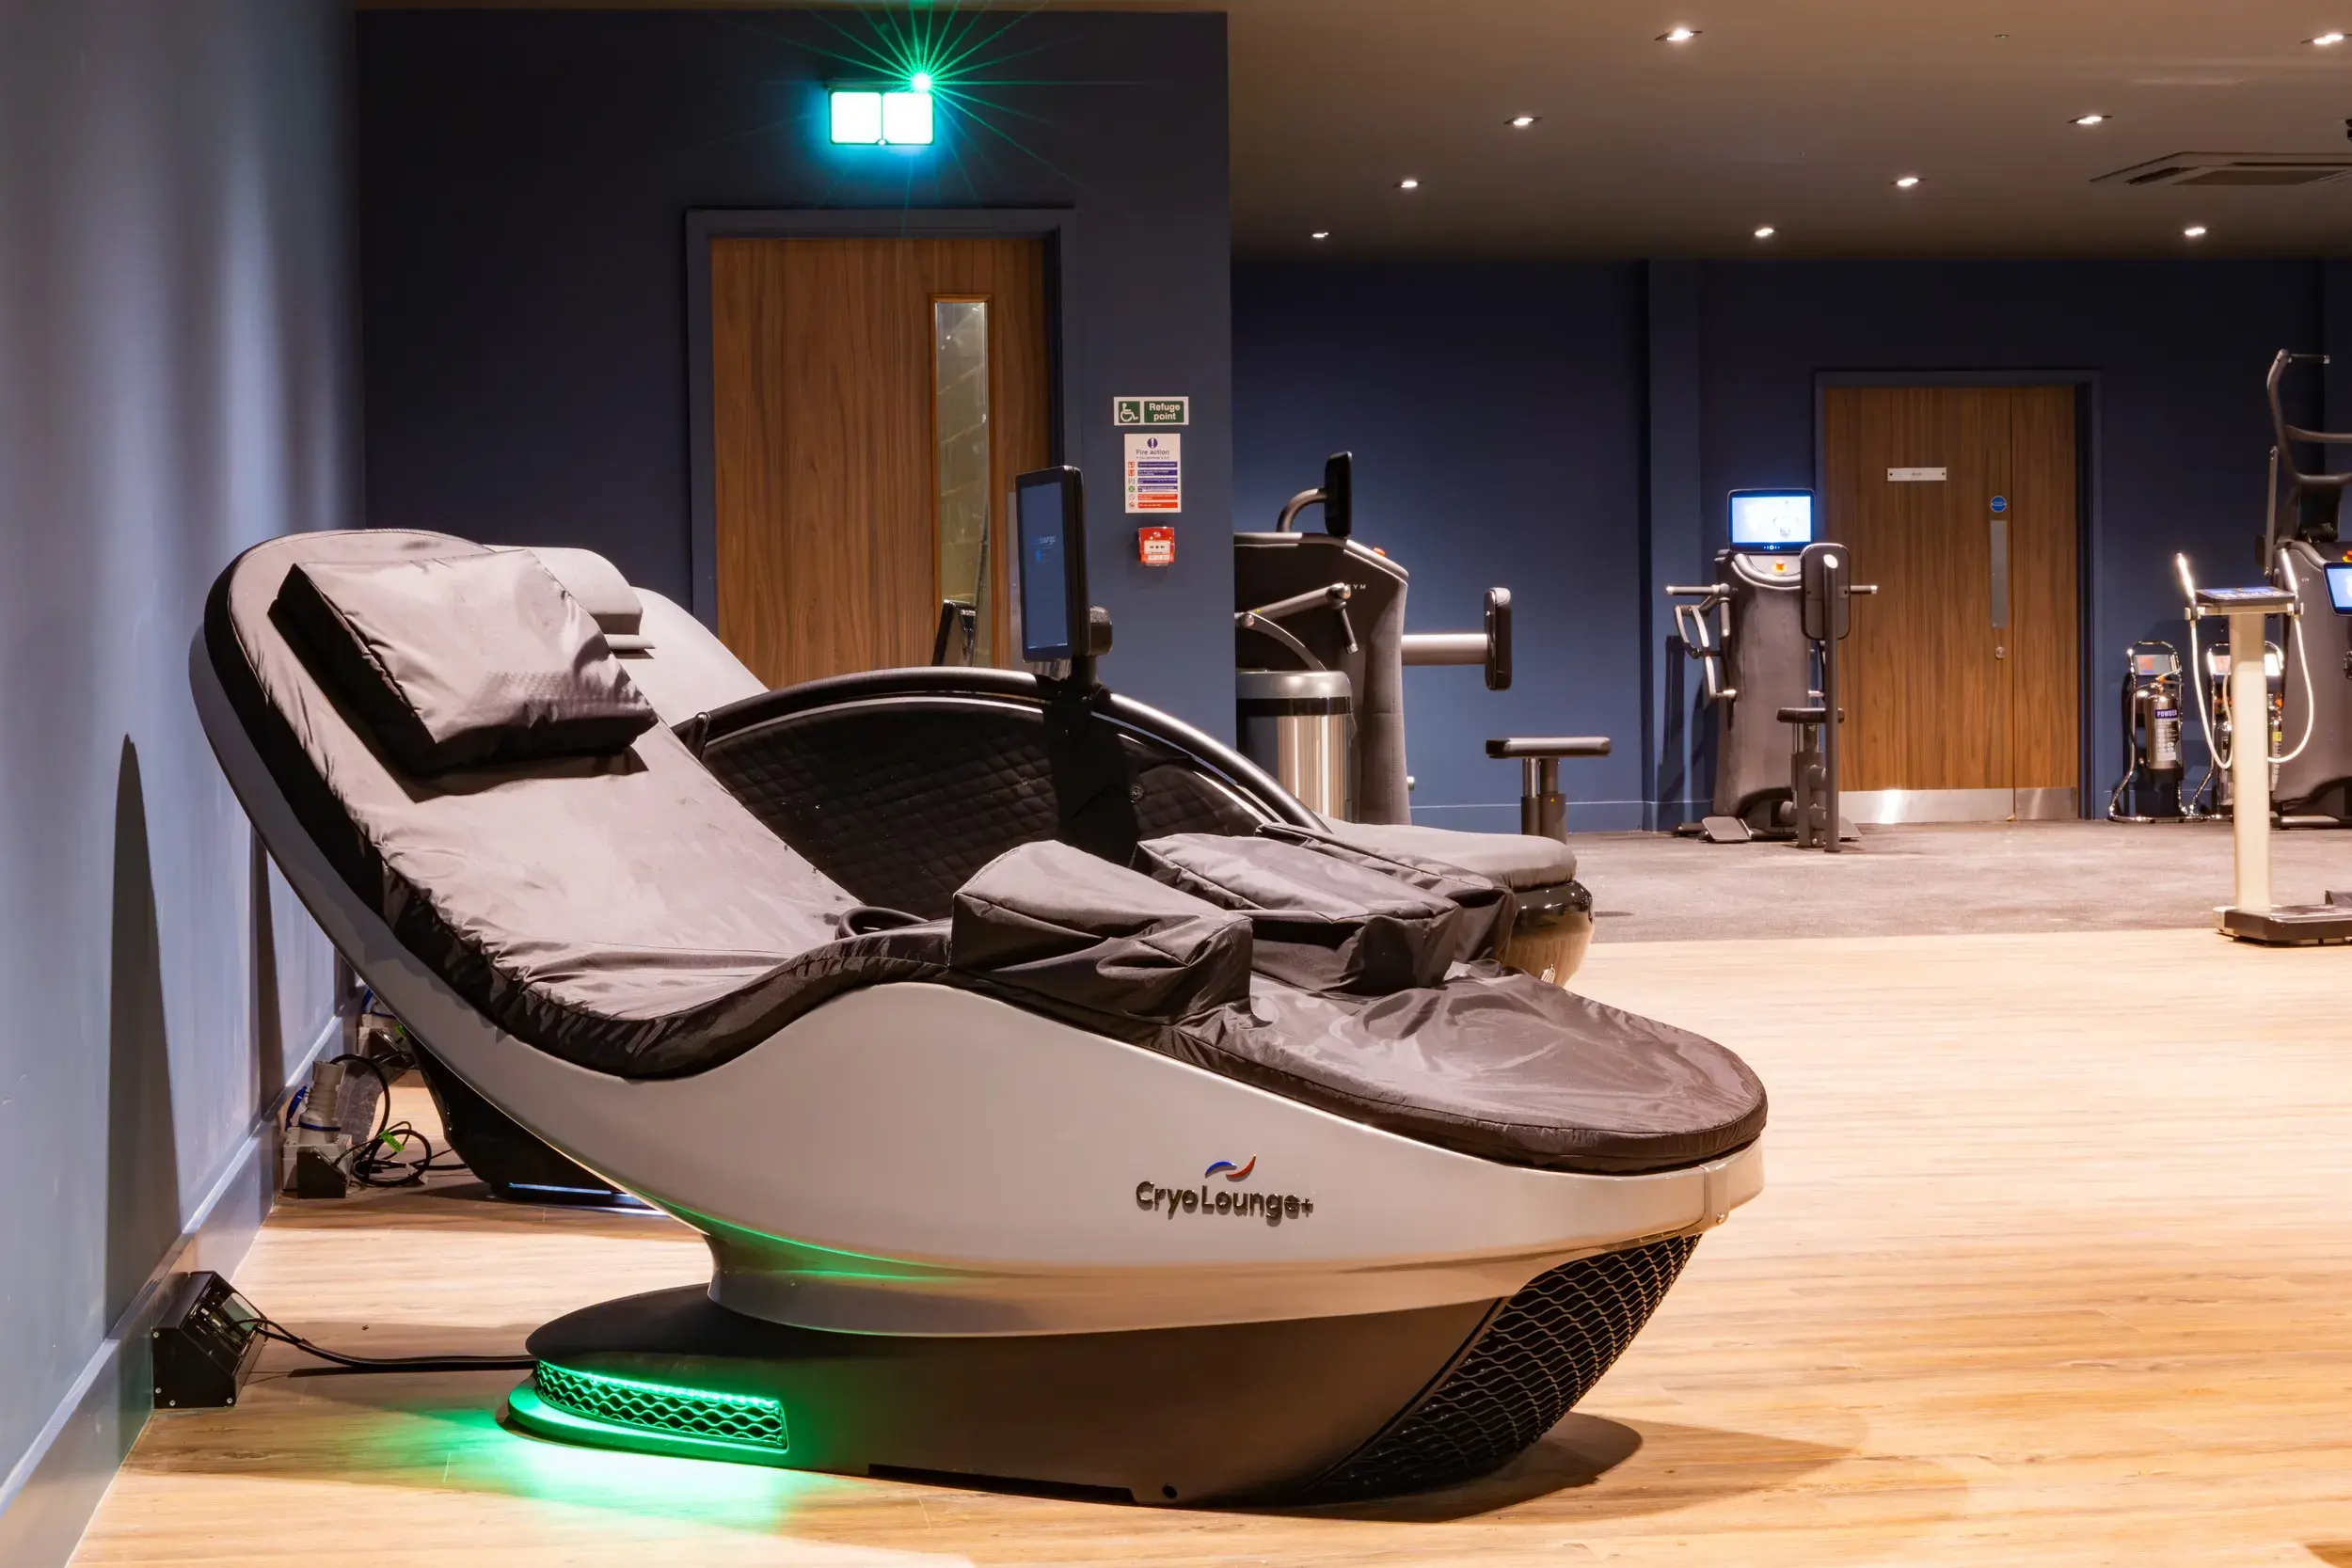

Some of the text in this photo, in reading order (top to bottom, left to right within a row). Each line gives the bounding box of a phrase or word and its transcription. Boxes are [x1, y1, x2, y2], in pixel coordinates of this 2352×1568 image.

[1149, 403, 1181, 413] Refuge
[1153, 412, 1176, 422] point
[1136, 1180, 1313, 1226] CryoLounge+
